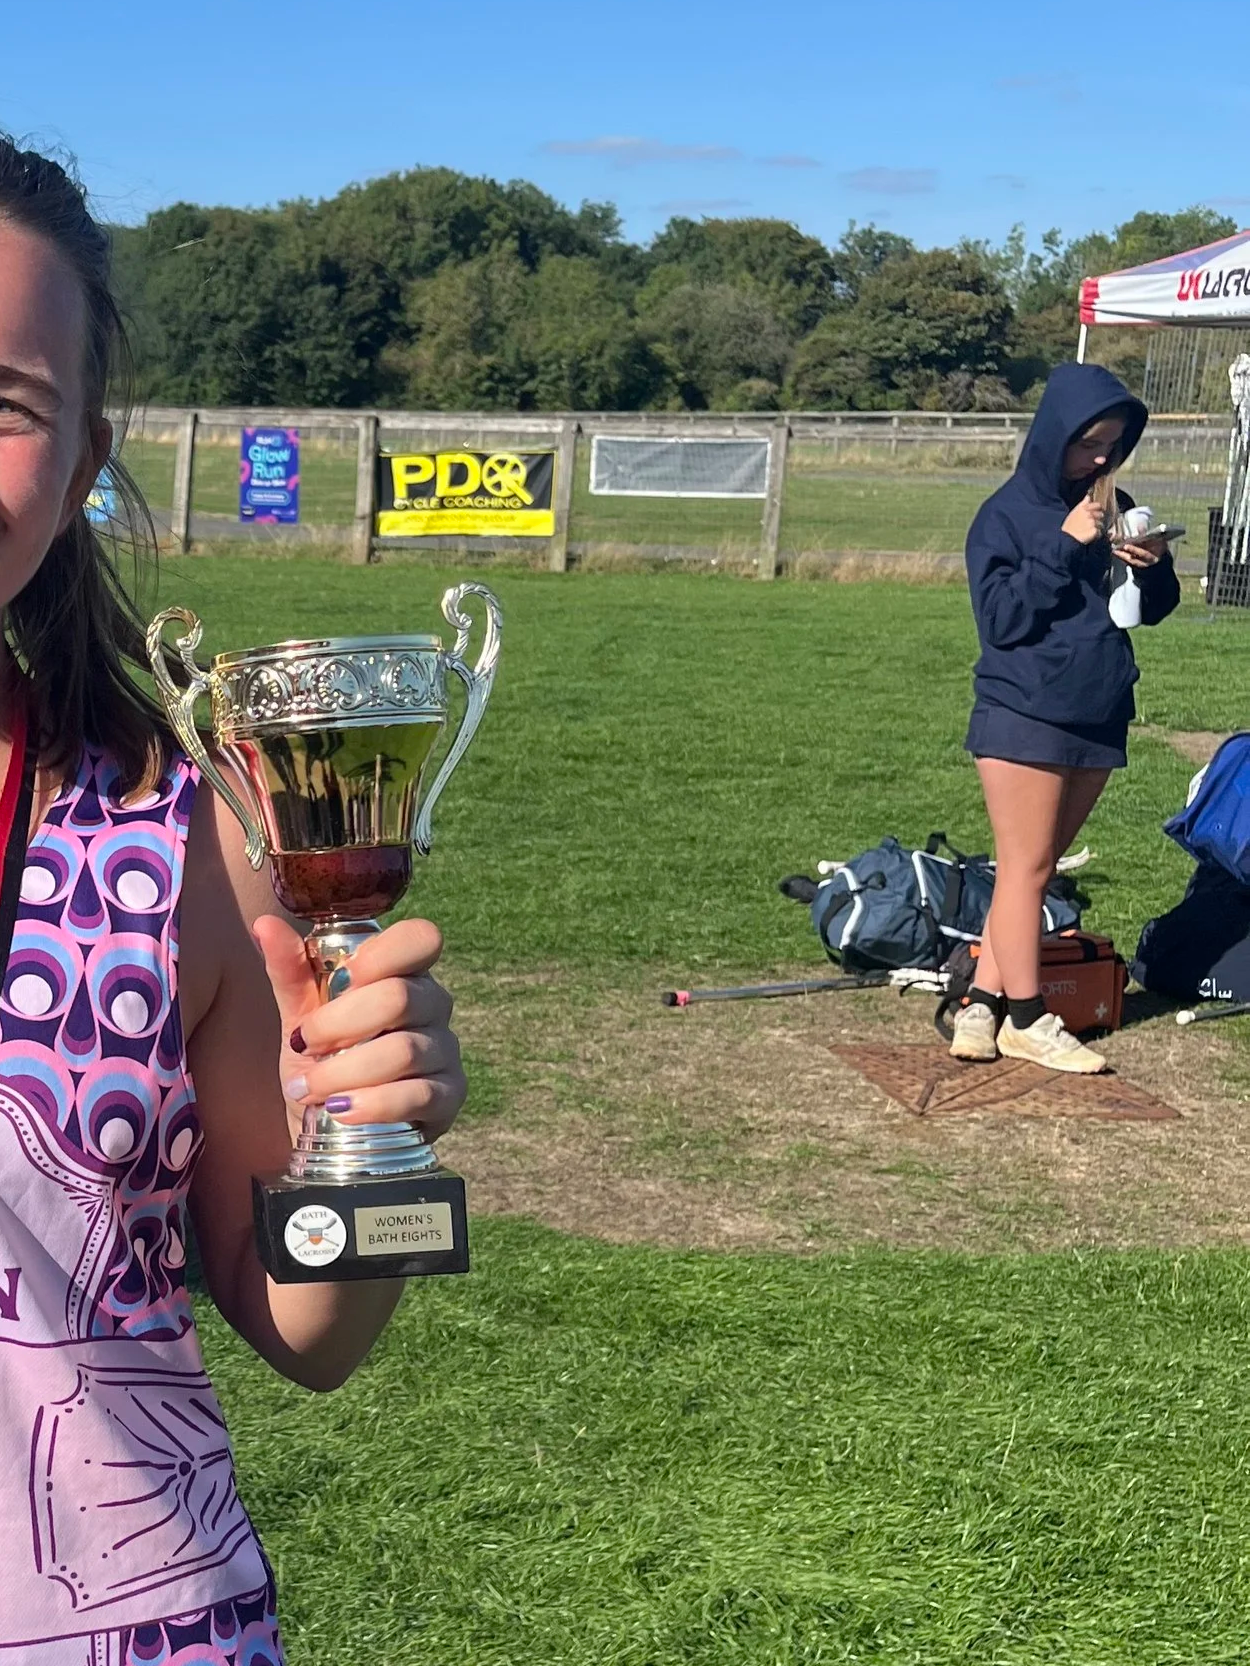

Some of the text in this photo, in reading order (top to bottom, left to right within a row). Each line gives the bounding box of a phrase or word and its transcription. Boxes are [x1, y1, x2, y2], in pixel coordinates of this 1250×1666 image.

[1177, 268, 1250, 301] UKLACR
[248, 444, 291, 463] Glow
[253, 462, 285, 479] Run
[391, 453, 534, 506] PDQ
[393, 496, 523, 510] CYCLE COACHING
[1040, 980, 1077, 996] ORTS
[301, 1211, 327, 1219] BATH
[375, 1214, 433, 1227] WOMEN'S
[368, 1230, 442, 1244] BATH EIGHTS
